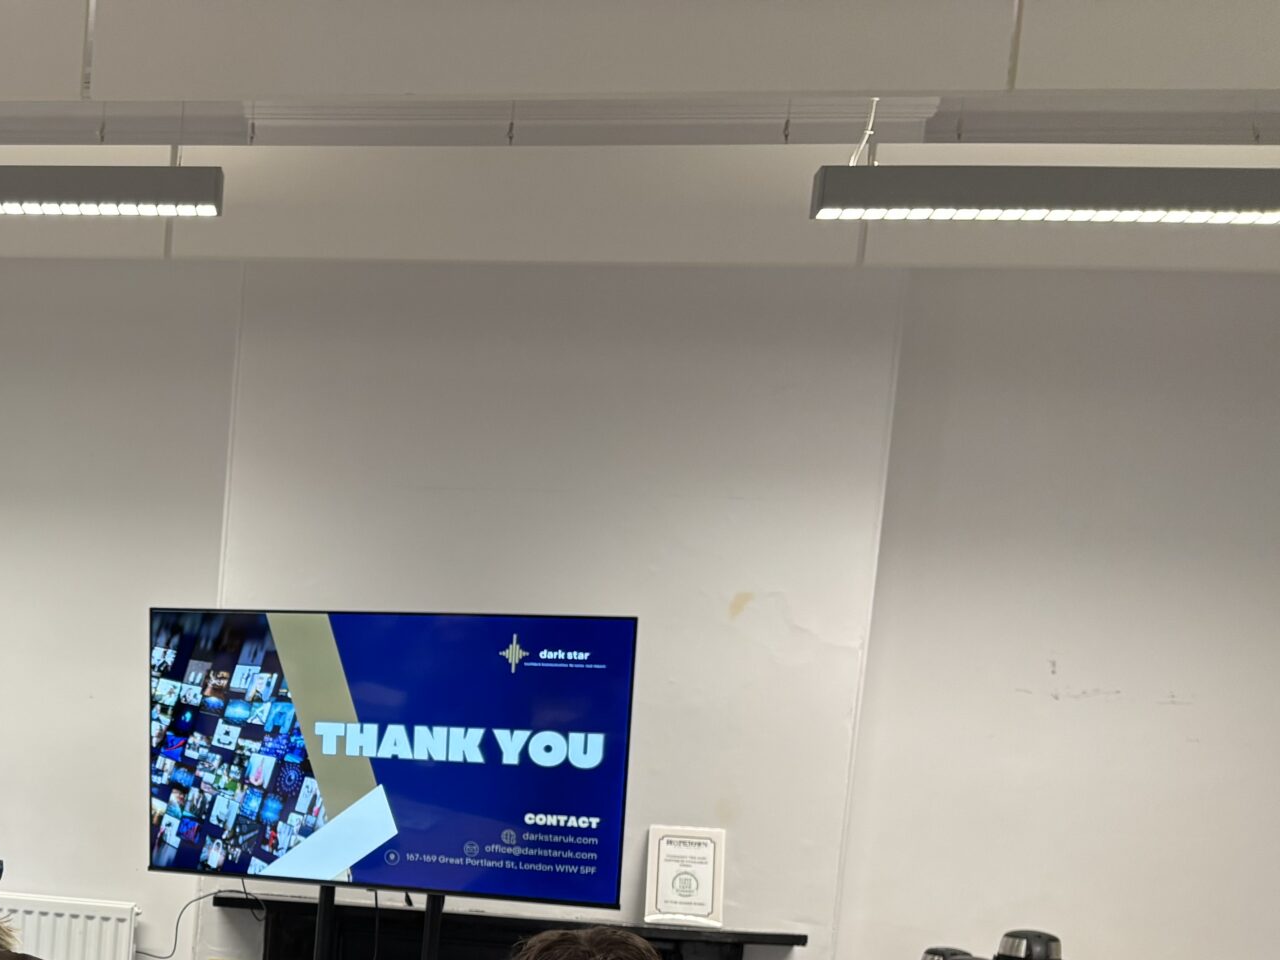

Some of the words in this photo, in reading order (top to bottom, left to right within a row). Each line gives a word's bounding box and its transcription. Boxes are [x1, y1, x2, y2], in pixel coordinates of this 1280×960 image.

[539, 649, 565, 660] dark
[567, 650, 590, 661] star
[314, 721, 486, 763] THANK
[492, 728, 605, 769] YOU
[524, 812, 601, 829] CONTACT
[522, 831, 599, 845] darkstaruk.com
[484, 843, 598, 860] office@darkstaruk.com
[405, 853, 437, 863] 167-169
[438, 854, 464, 865] Great
[465, 857, 504, 868] Portland
[519, 861, 553, 872] London
